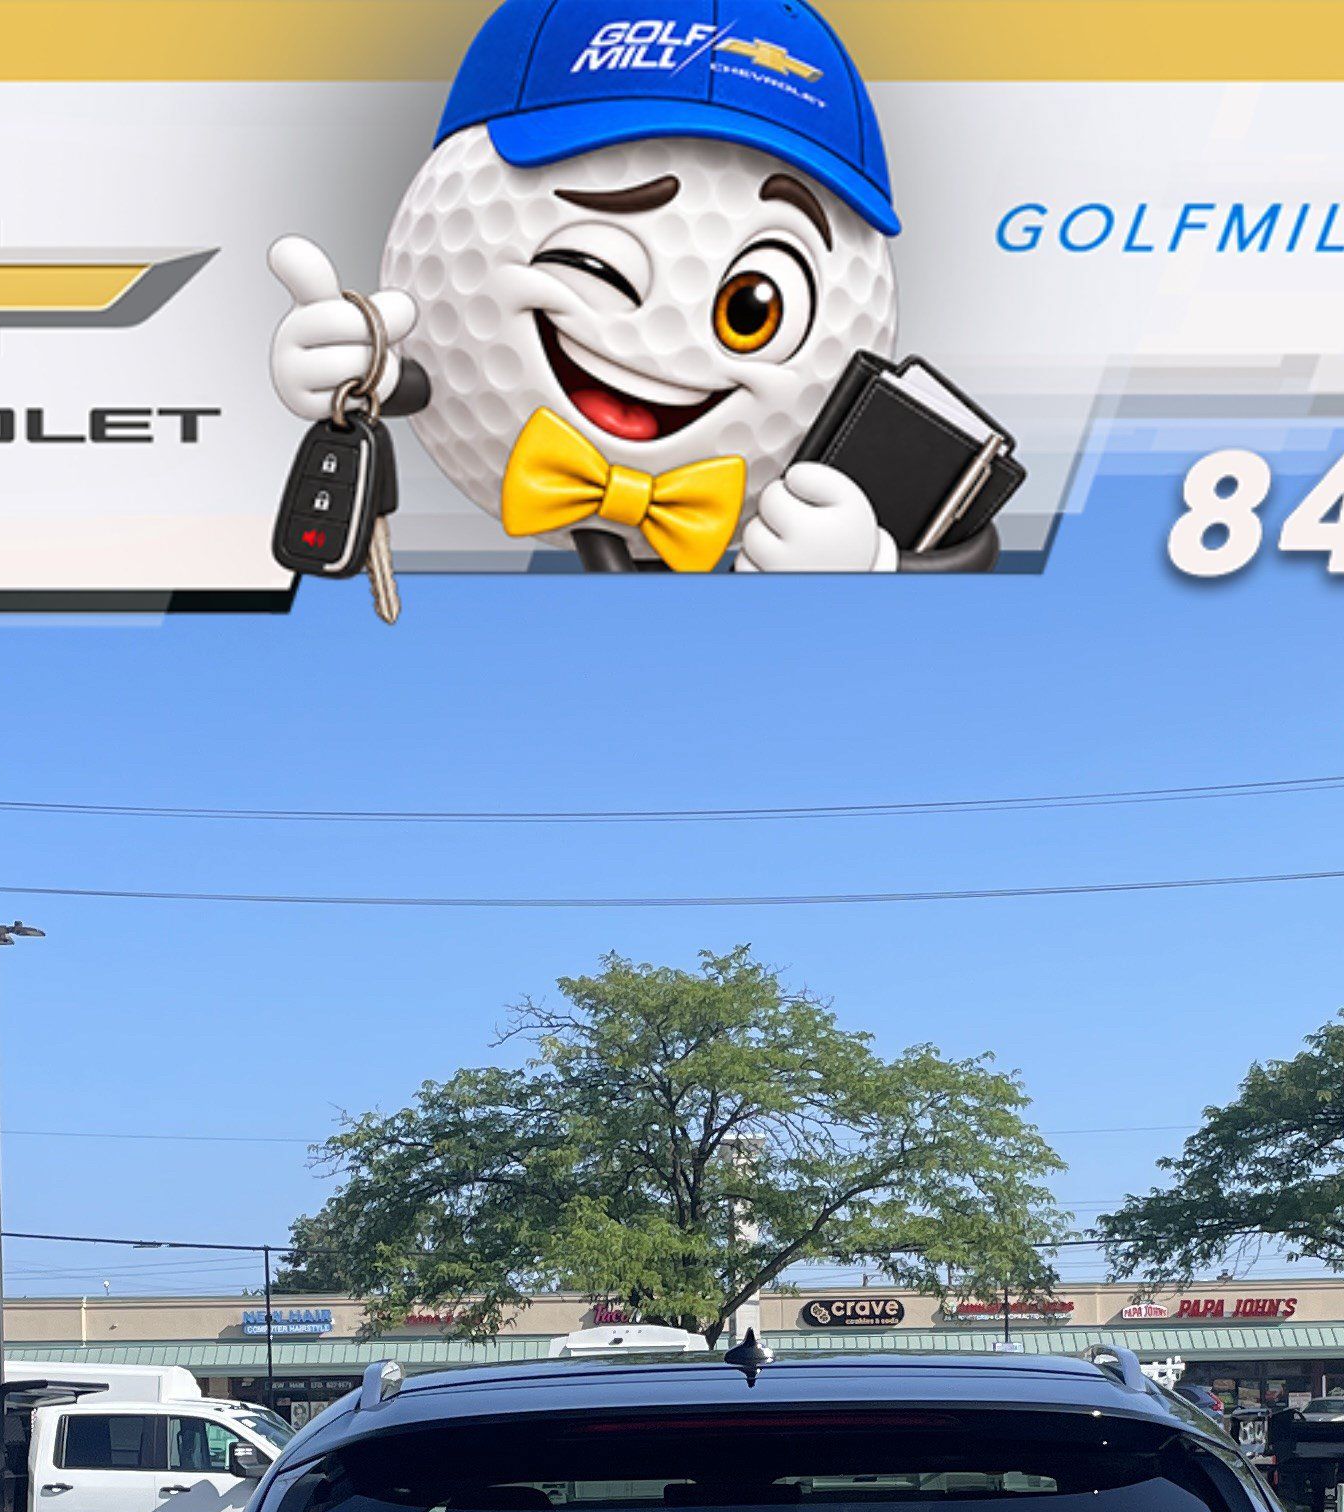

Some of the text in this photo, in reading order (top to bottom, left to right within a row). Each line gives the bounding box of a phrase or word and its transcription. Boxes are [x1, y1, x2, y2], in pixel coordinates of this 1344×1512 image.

[831, 1301, 899, 1317] crave
[1124, 1307, 1142, 1318] PAPA
[1176, 1298, 1298, 1318] PAPA JOHN'S
[288, 1309, 332, 1322] HAIR
